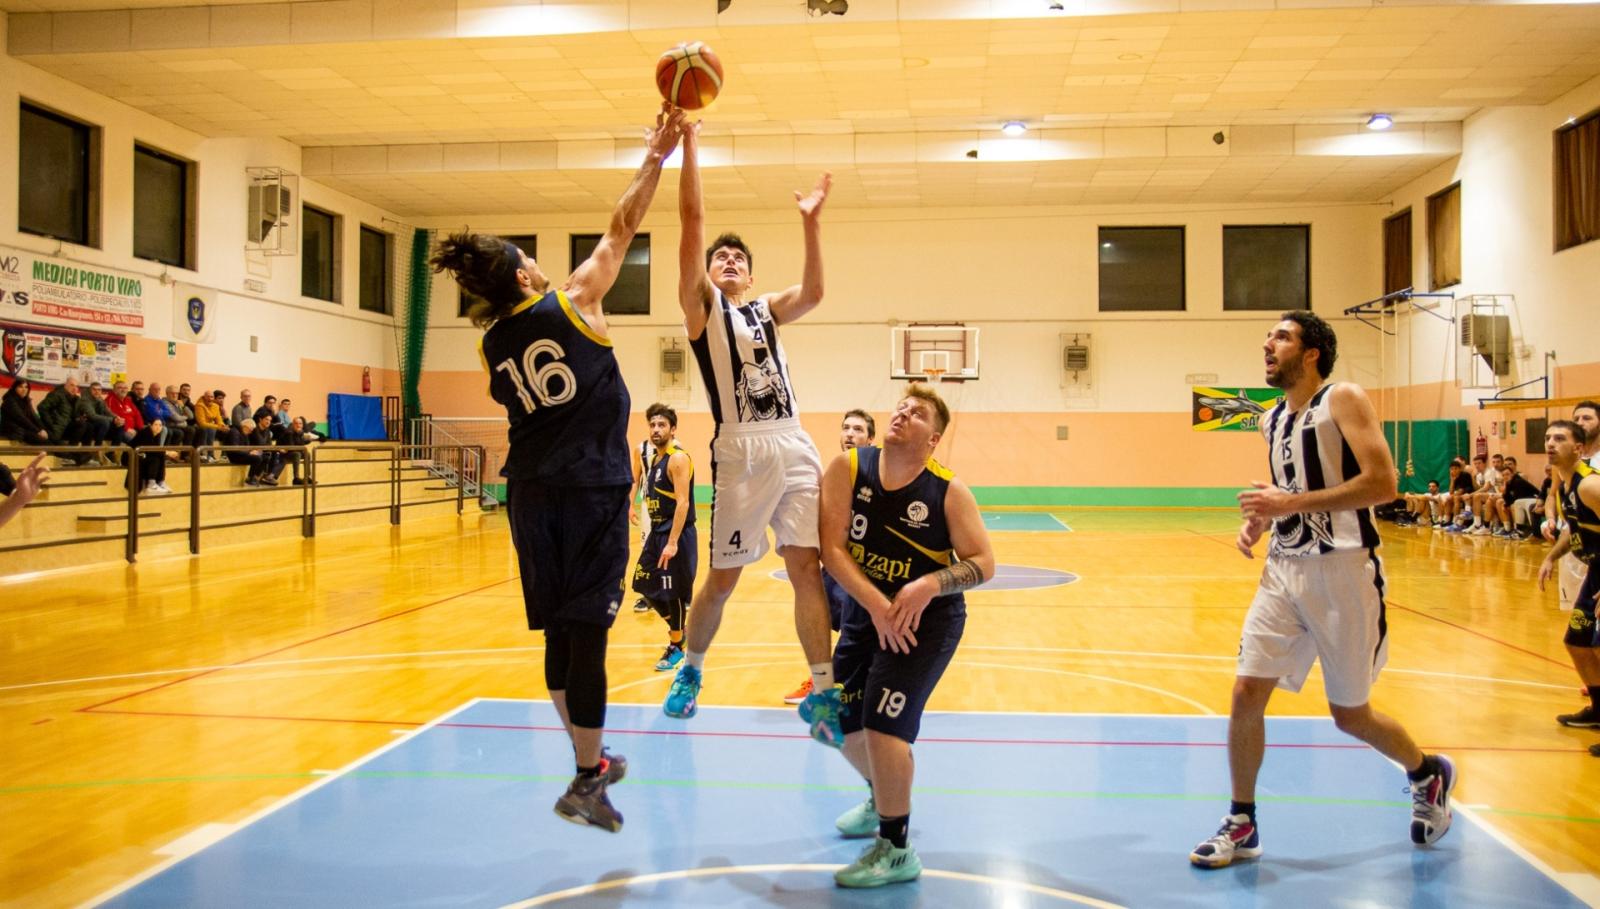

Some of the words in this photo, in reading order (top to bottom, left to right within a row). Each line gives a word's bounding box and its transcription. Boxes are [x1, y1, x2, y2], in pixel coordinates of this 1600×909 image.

[32, 260, 78, 287] MEDICA
[80, 270, 115, 293] PORTO
[117, 277, 142, 297] VIRO
[752, 327, 765, 344] 4
[496, 338, 577, 414] 16
[1281, 440, 1293, 461] 15
[728, 529, 742, 550] 4
[851, 510, 868, 540] 9
[661, 575, 673, 590] 11
[866, 552, 912, 583] zapi
[876, 687, 907, 718] 19
